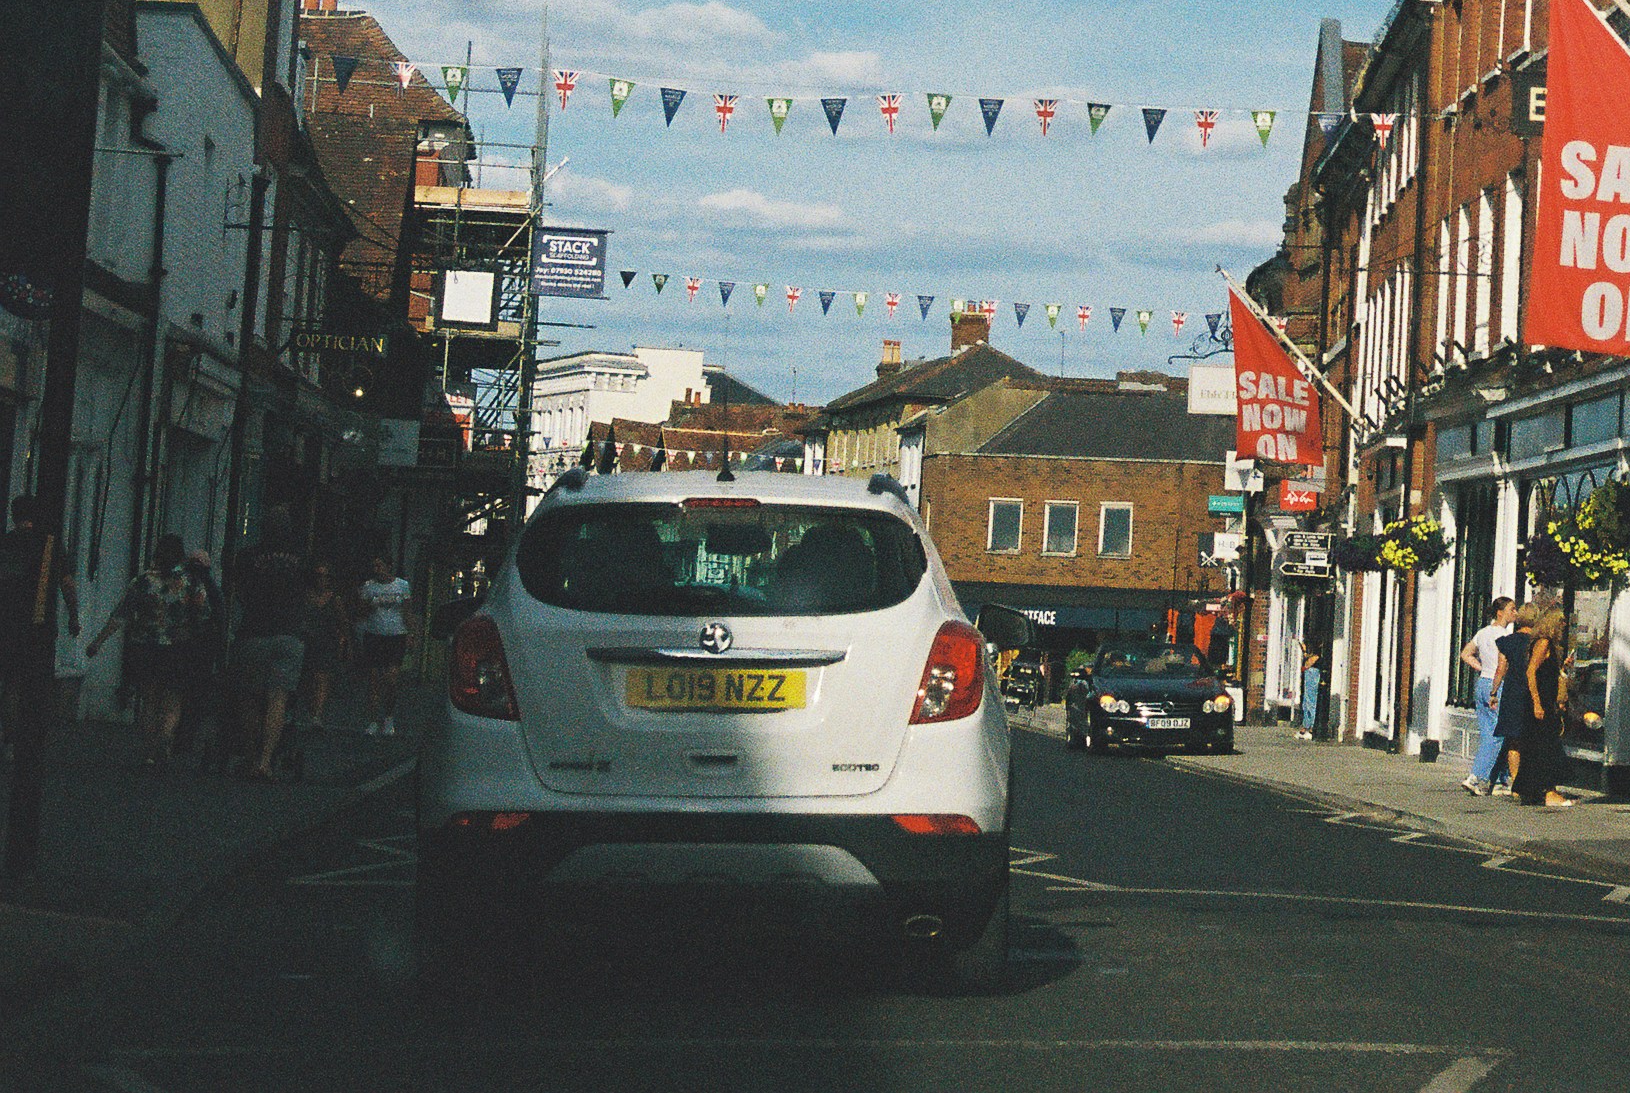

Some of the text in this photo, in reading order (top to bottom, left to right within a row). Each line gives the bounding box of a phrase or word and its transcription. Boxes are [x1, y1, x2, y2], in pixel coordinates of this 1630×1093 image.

[549, 240, 591, 255] STACK
[296, 333, 384, 353] OPTICIAN
[1238, 369, 1309, 406] SALE
[1242, 403, 1307, 435] NOW
[1256, 432, 1298, 462] ON
[645, 673, 787, 702] LO19 NZZ
